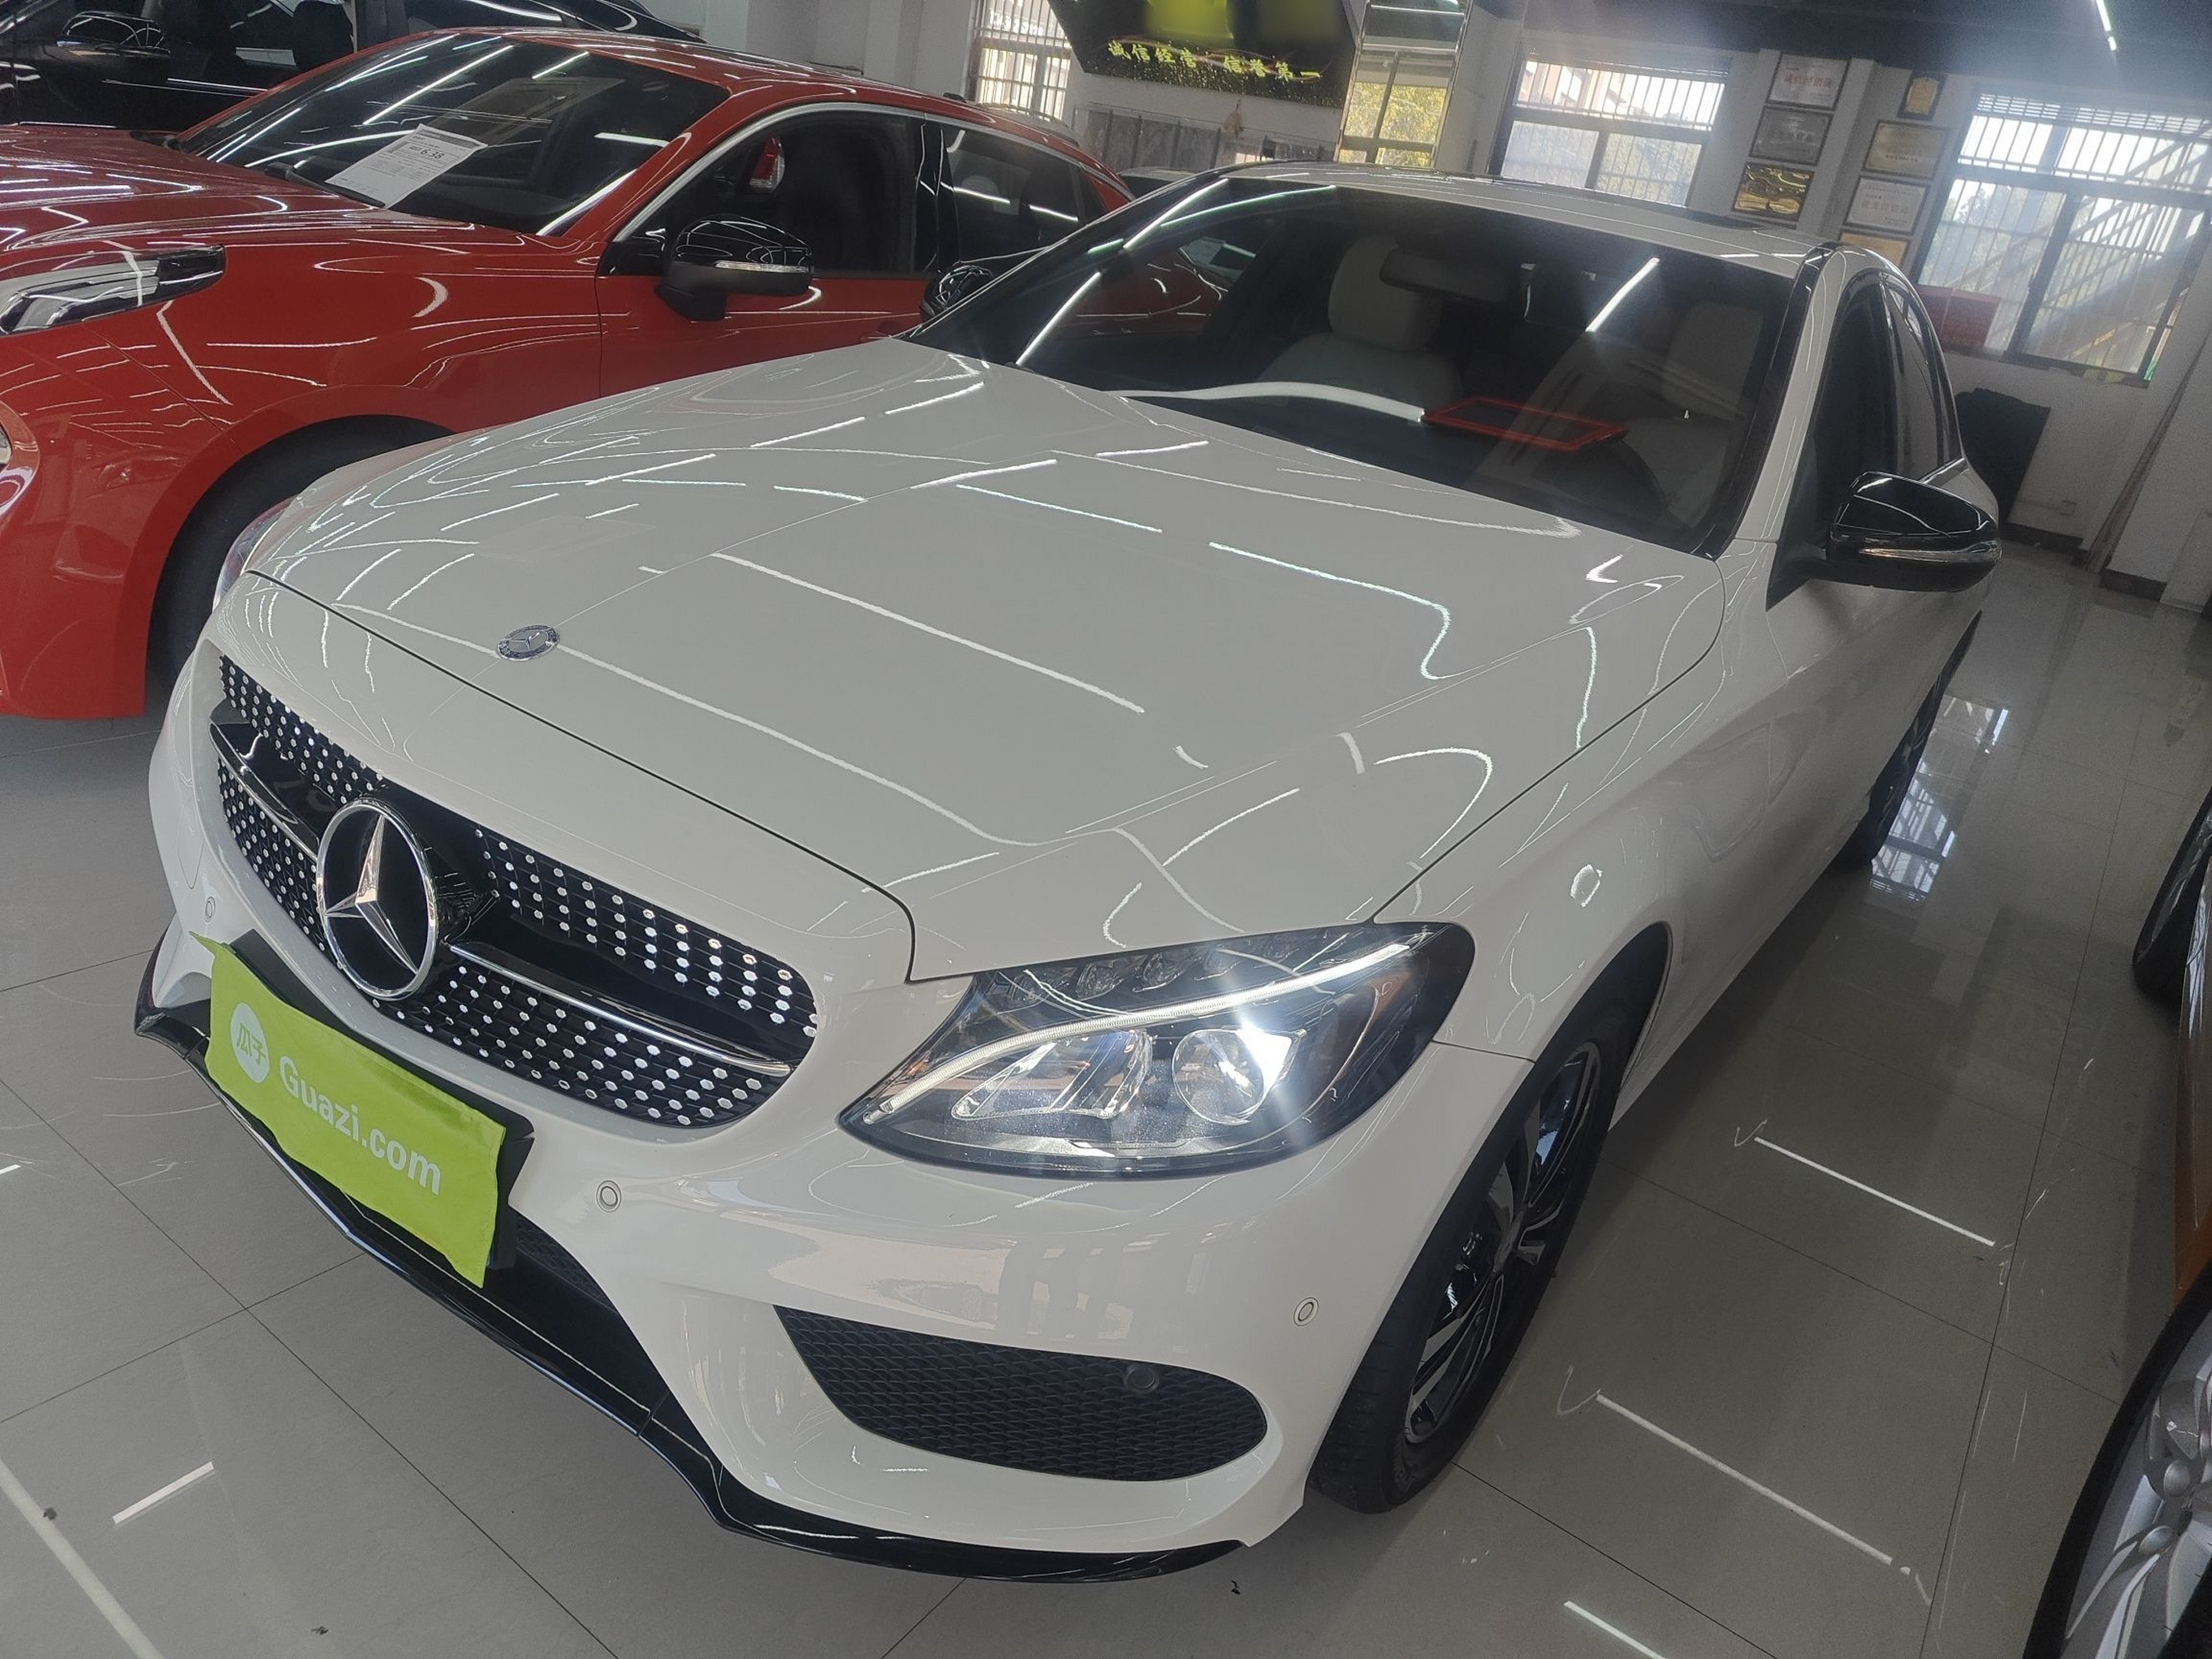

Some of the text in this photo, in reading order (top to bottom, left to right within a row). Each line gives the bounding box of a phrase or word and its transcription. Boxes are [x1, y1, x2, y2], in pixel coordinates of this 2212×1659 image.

[1108, 40, 1321, 82] 诚信经营 信誉第一
[237, 1022, 266, 1065] 瓜子
[279, 1055, 441, 1195] Guazi.com
